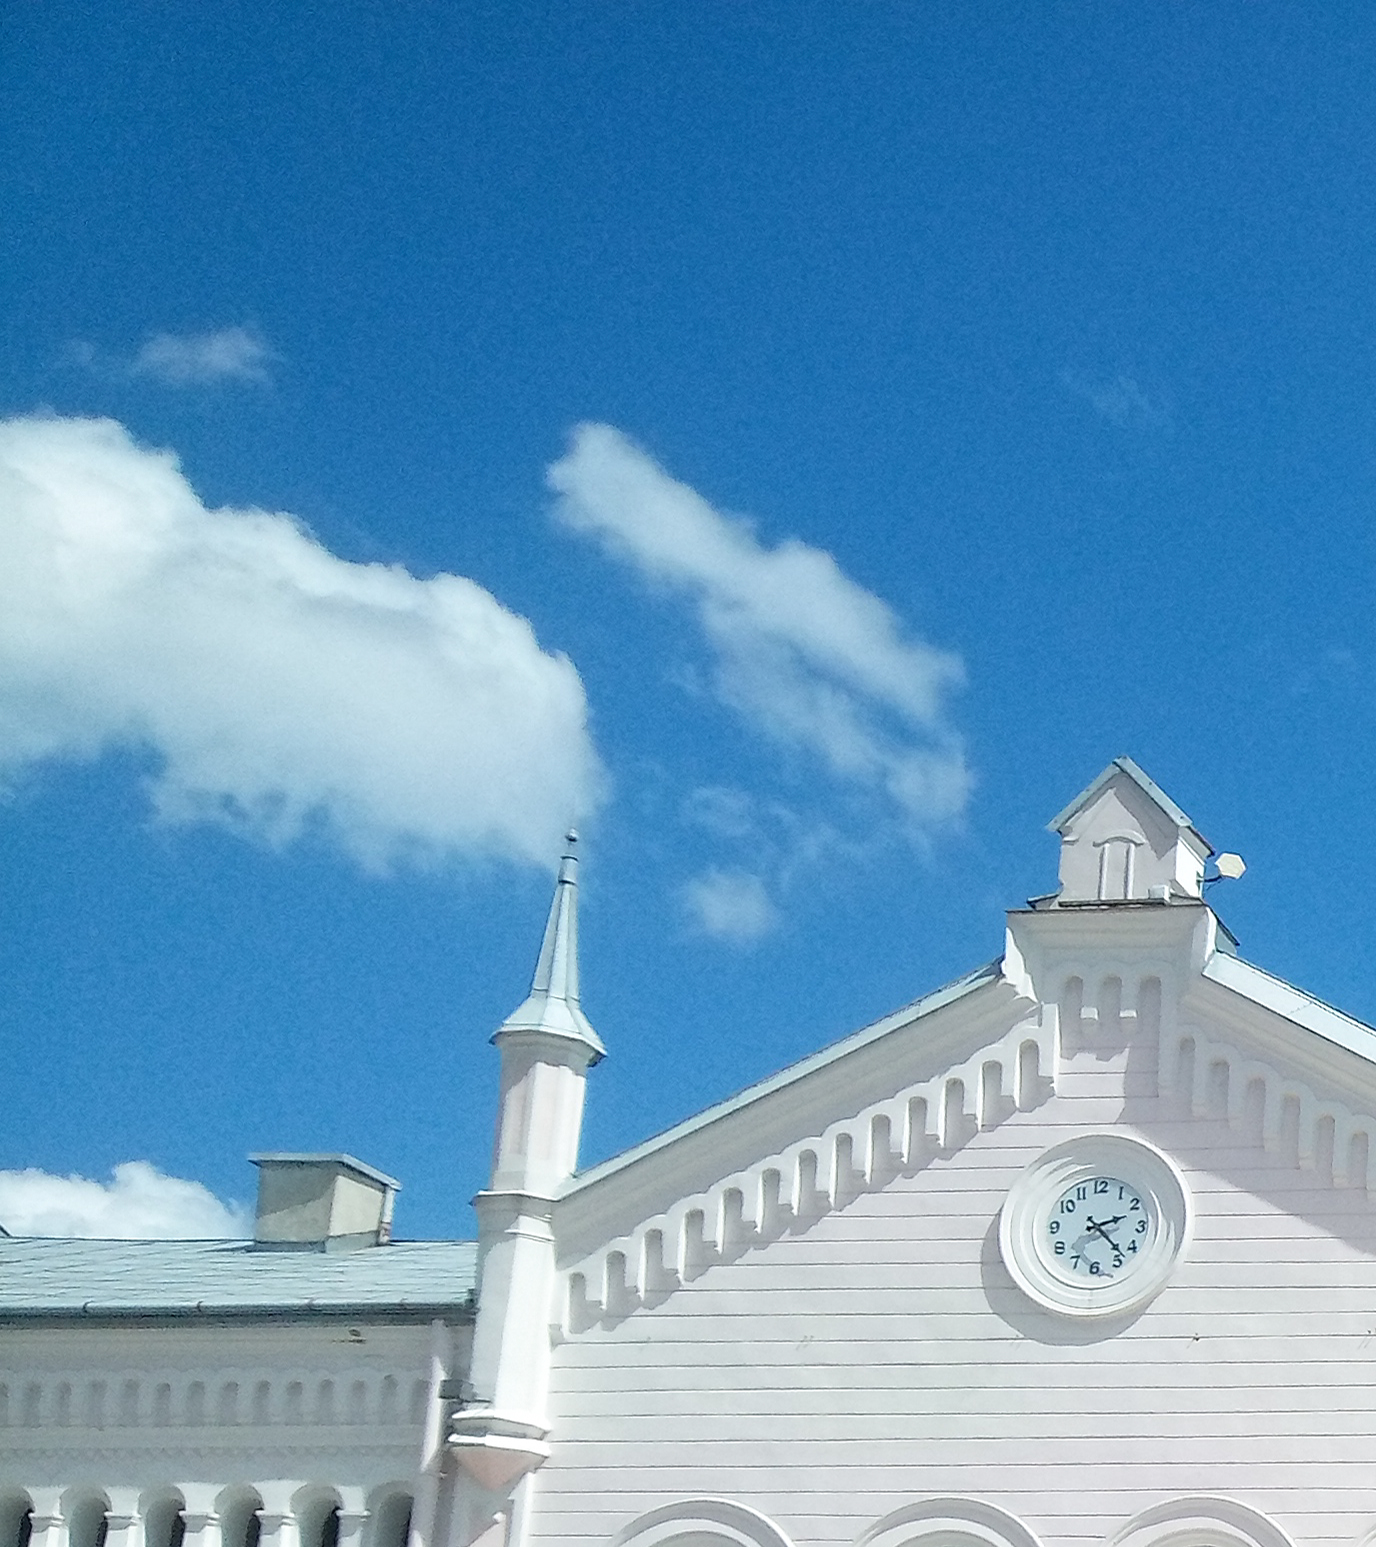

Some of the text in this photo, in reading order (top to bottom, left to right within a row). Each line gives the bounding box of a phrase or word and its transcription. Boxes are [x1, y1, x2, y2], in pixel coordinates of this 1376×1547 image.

[1077, 1187, 1086, 1200] 11
[1094, 1180, 1109, 1194] 12
[1118, 1186, 1124, 1200] 1
[1060, 1199, 1076, 1214] 10
[1130, 1198, 1140, 1211] 2
[1049, 1221, 1060, 1234] 9
[1135, 1220, 1146, 1233] 3
[1054, 1241, 1065, 1254] 8
[1127, 1239, 1137, 1253] 4
[1070, 1255, 1080, 1270] 7
[1089, 1261, 1100, 1275] 6
[1112, 1254, 1123, 1268] 5
